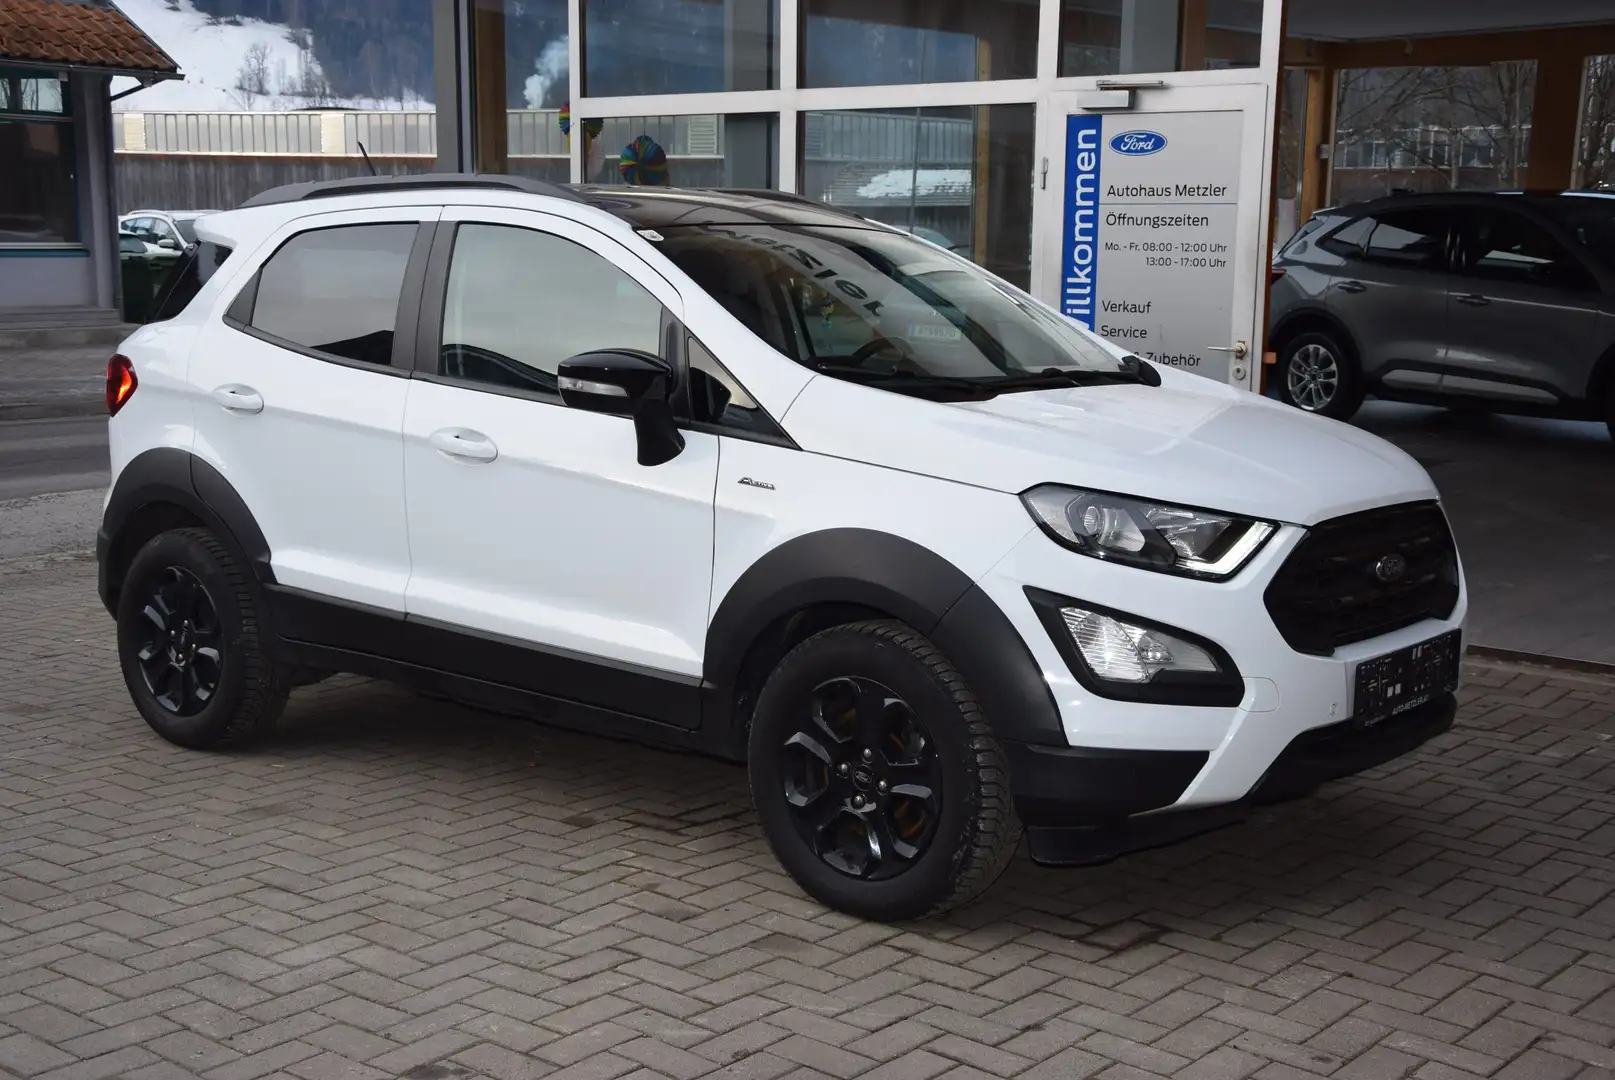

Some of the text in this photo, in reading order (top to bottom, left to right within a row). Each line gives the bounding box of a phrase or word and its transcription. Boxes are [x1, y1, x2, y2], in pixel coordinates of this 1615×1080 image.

[1120, 133, 1155, 151] Ford
[1107, 184, 1227, 197] Autohaus Metzler
[1105, 211, 1209, 229] Öffnungszeiten
[1105, 242, 1121, 251] Mo.
[1129, 242, 1140, 251] Fr.
[1142, 242, 1172, 252] 08:00
[1181, 243, 1207, 252] 12:00
[1209, 243, 1227, 253] Uhr
[1146, 257, 1172, 266] 13:00
[1180, 258, 1206, 267] 17:00
[1209, 258, 1227, 268] Uhr
[1102, 300, 1151, 314] Verkauf
[1101, 325, 1147, 338] Service
